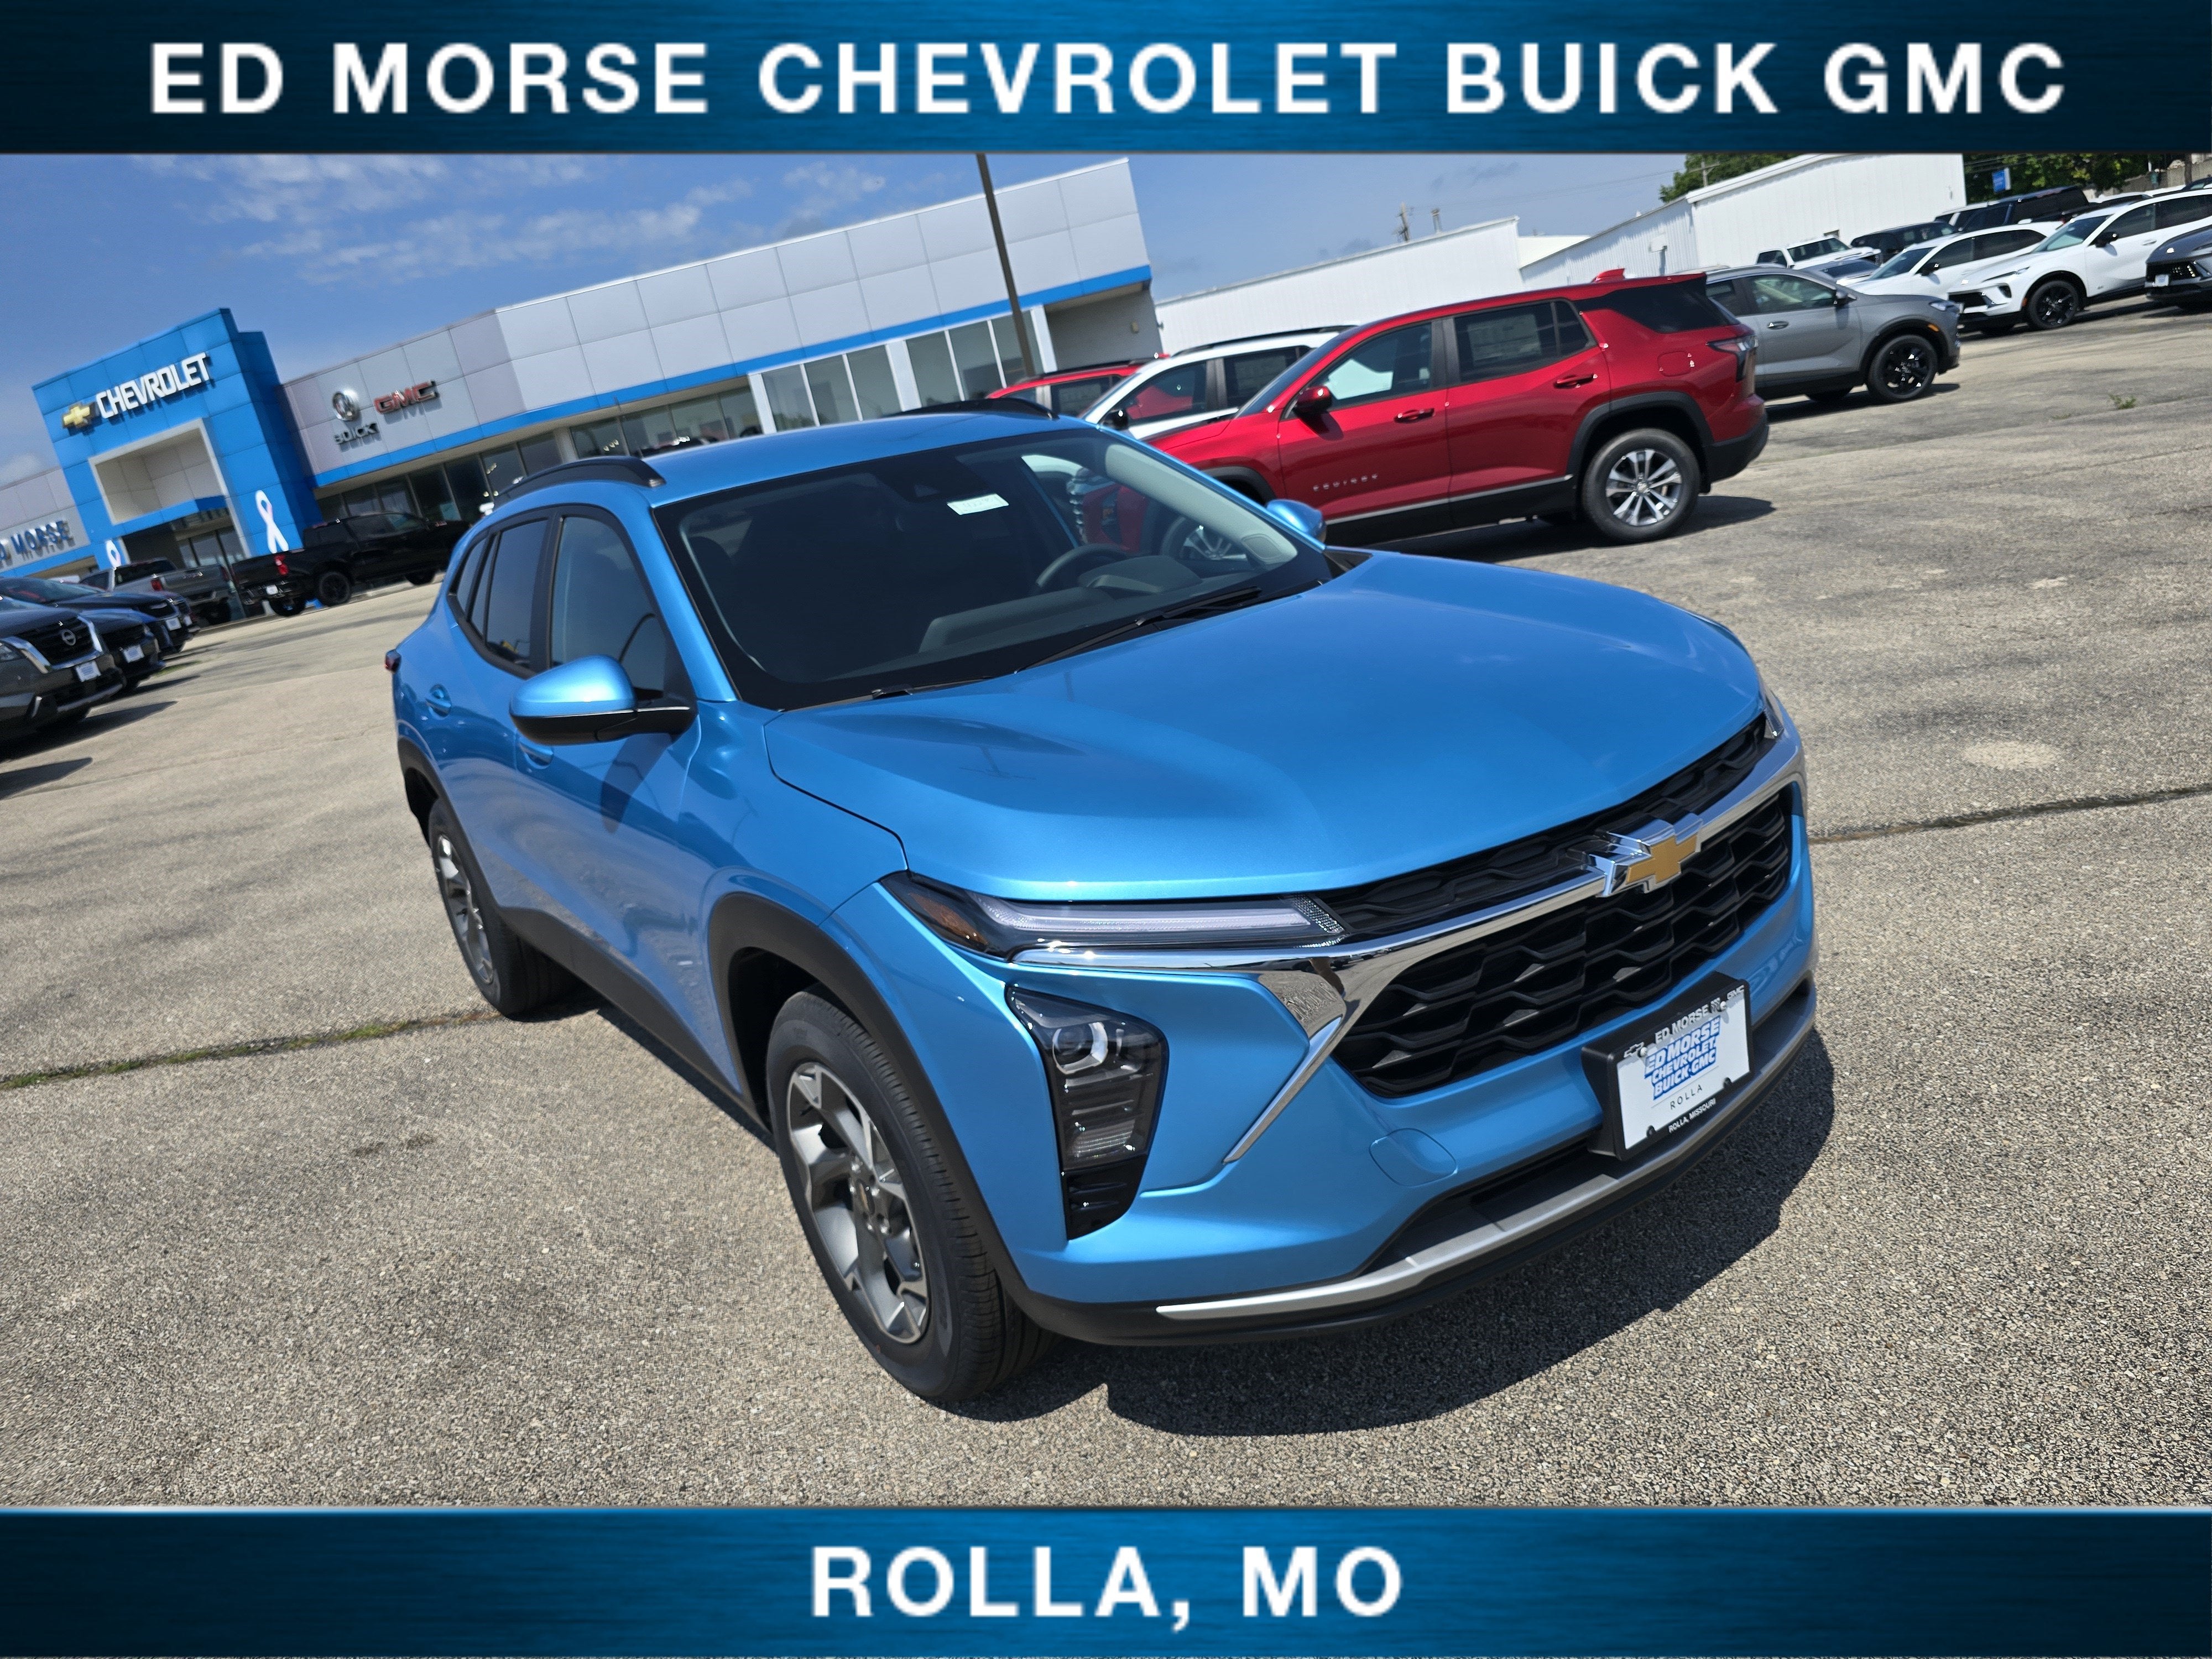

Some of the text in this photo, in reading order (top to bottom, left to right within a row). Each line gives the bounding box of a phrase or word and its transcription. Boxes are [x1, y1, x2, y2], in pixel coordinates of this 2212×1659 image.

[96, 352, 210, 419] CHEVROLET
[374, 380, 439, 414] GMC
[334, 422, 379, 444] BUICK
[1313, 474, 1378, 491] EQUINOX
[11, 520, 69, 554] MORSE
[1655, 1004, 1708, 1044] ED MORSE
[1646, 1016, 1720, 1076] ED MORSE
[1652, 1037, 1716, 1084] CHEVROLET
[1670, 1084, 1703, 1110] ROLLA
[1689, 1098, 1717, 1120] MISSOURI
